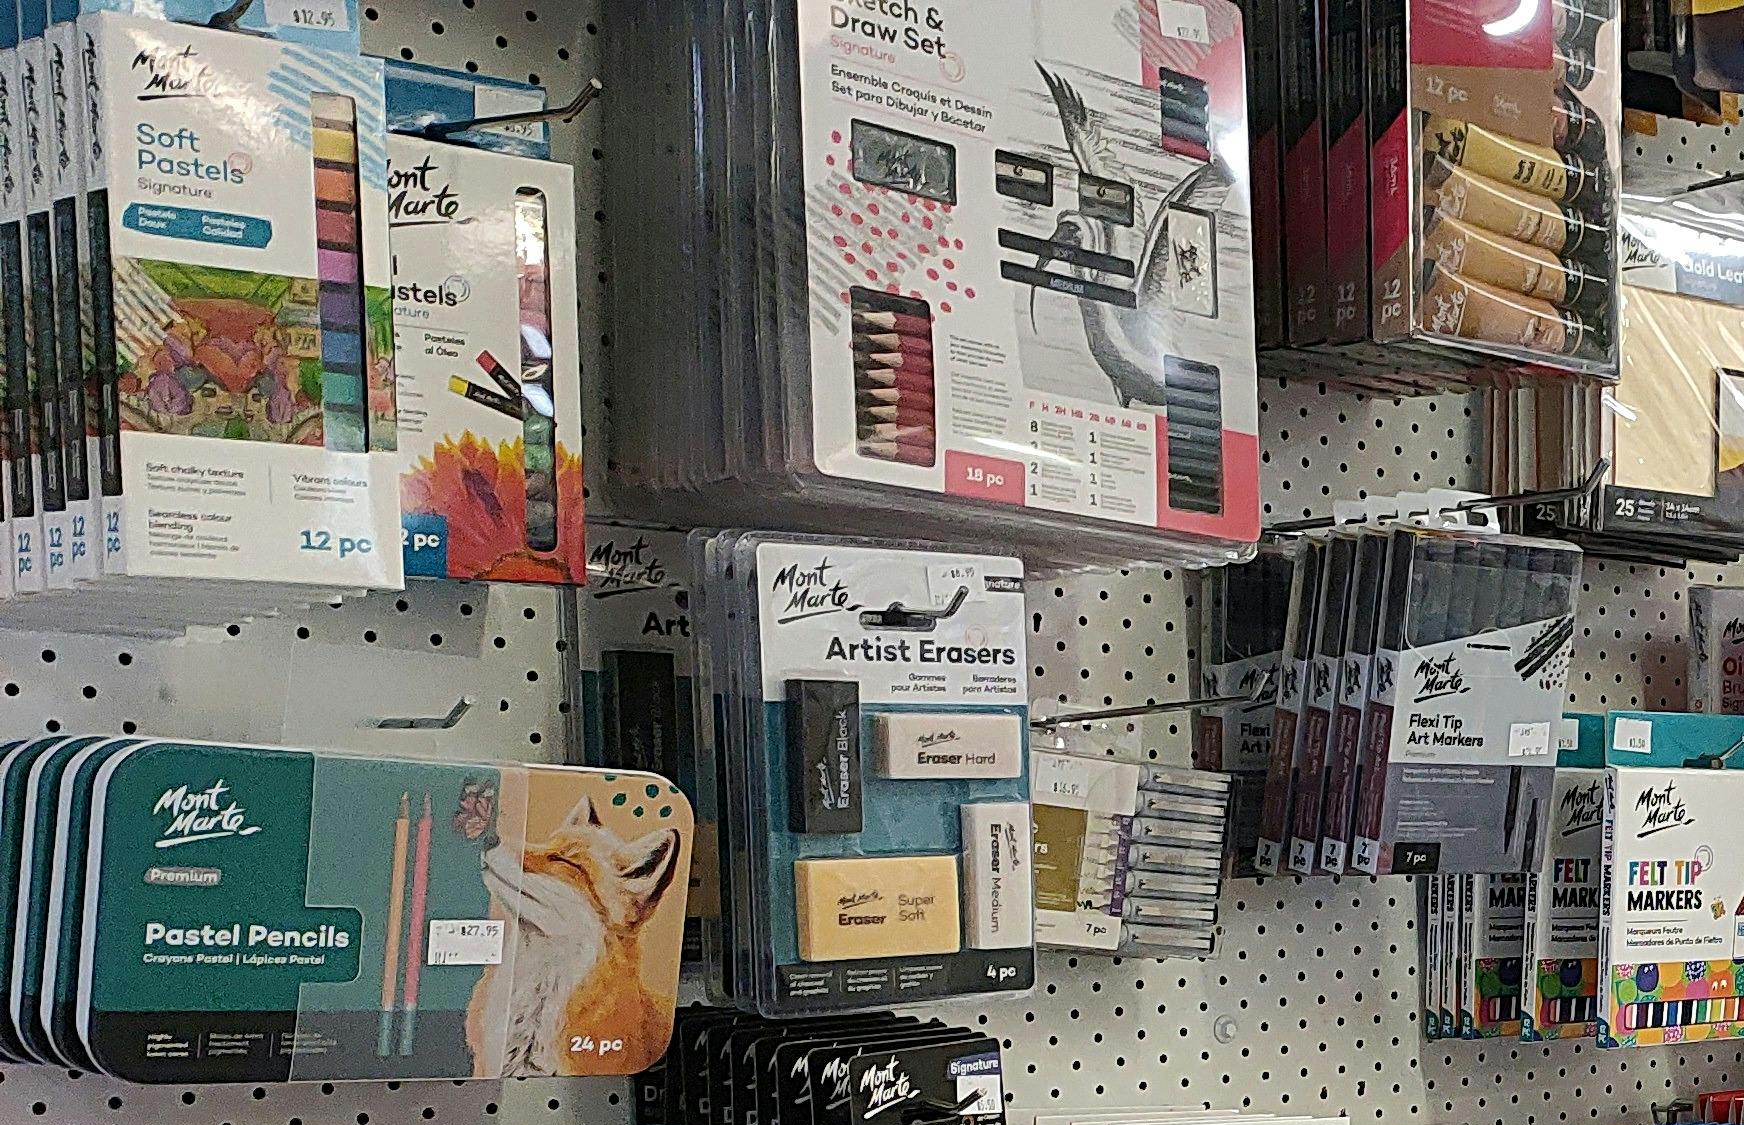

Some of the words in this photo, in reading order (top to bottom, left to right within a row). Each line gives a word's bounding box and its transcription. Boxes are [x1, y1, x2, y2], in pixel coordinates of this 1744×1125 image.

[831, 9, 898, 44] Draw
[904, 27, 946, 59] Set
[137, 122, 200, 152] Soft
[138, 150, 244, 184] Pastels
[138, 177, 212, 199] Signature
[1615, 499, 1634, 517] 25
[301, 529, 331, 551] 12
[338, 536, 371, 558] pc
[773, 558, 832, 592] Mont
[826, 637, 912, 663] Artist
[919, 639, 1015, 665] Erasers
[1409, 714, 1440, 729] Flexi
[1442, 716, 1462, 730] Tip
[1408, 732, 1429, 745] Art
[1432, 733, 1483, 747] Markers
[917, 752, 962, 764] Eraser
[965, 753, 995, 764] Hard
[155, 780, 227, 814] Mont
[1636, 780, 1675, 807] Mont
[149, 869, 219, 884] Premium
[1554, 859, 1589, 884] FELT
[1628, 861, 1667, 886] FELT
[1675, 862, 1702, 885] TIP
[838, 912, 886, 926] Eraser
[898, 894, 935, 908] Super
[1627, 889, 1702, 911] MARKERS
[145, 923, 241, 946] Pastel
[249, 925, 349, 949] Pencils
[461, 925, 499, 937] $27.95
[860, 1056, 899, 1091] Mont
[951, 1058, 998, 1075] Signature
